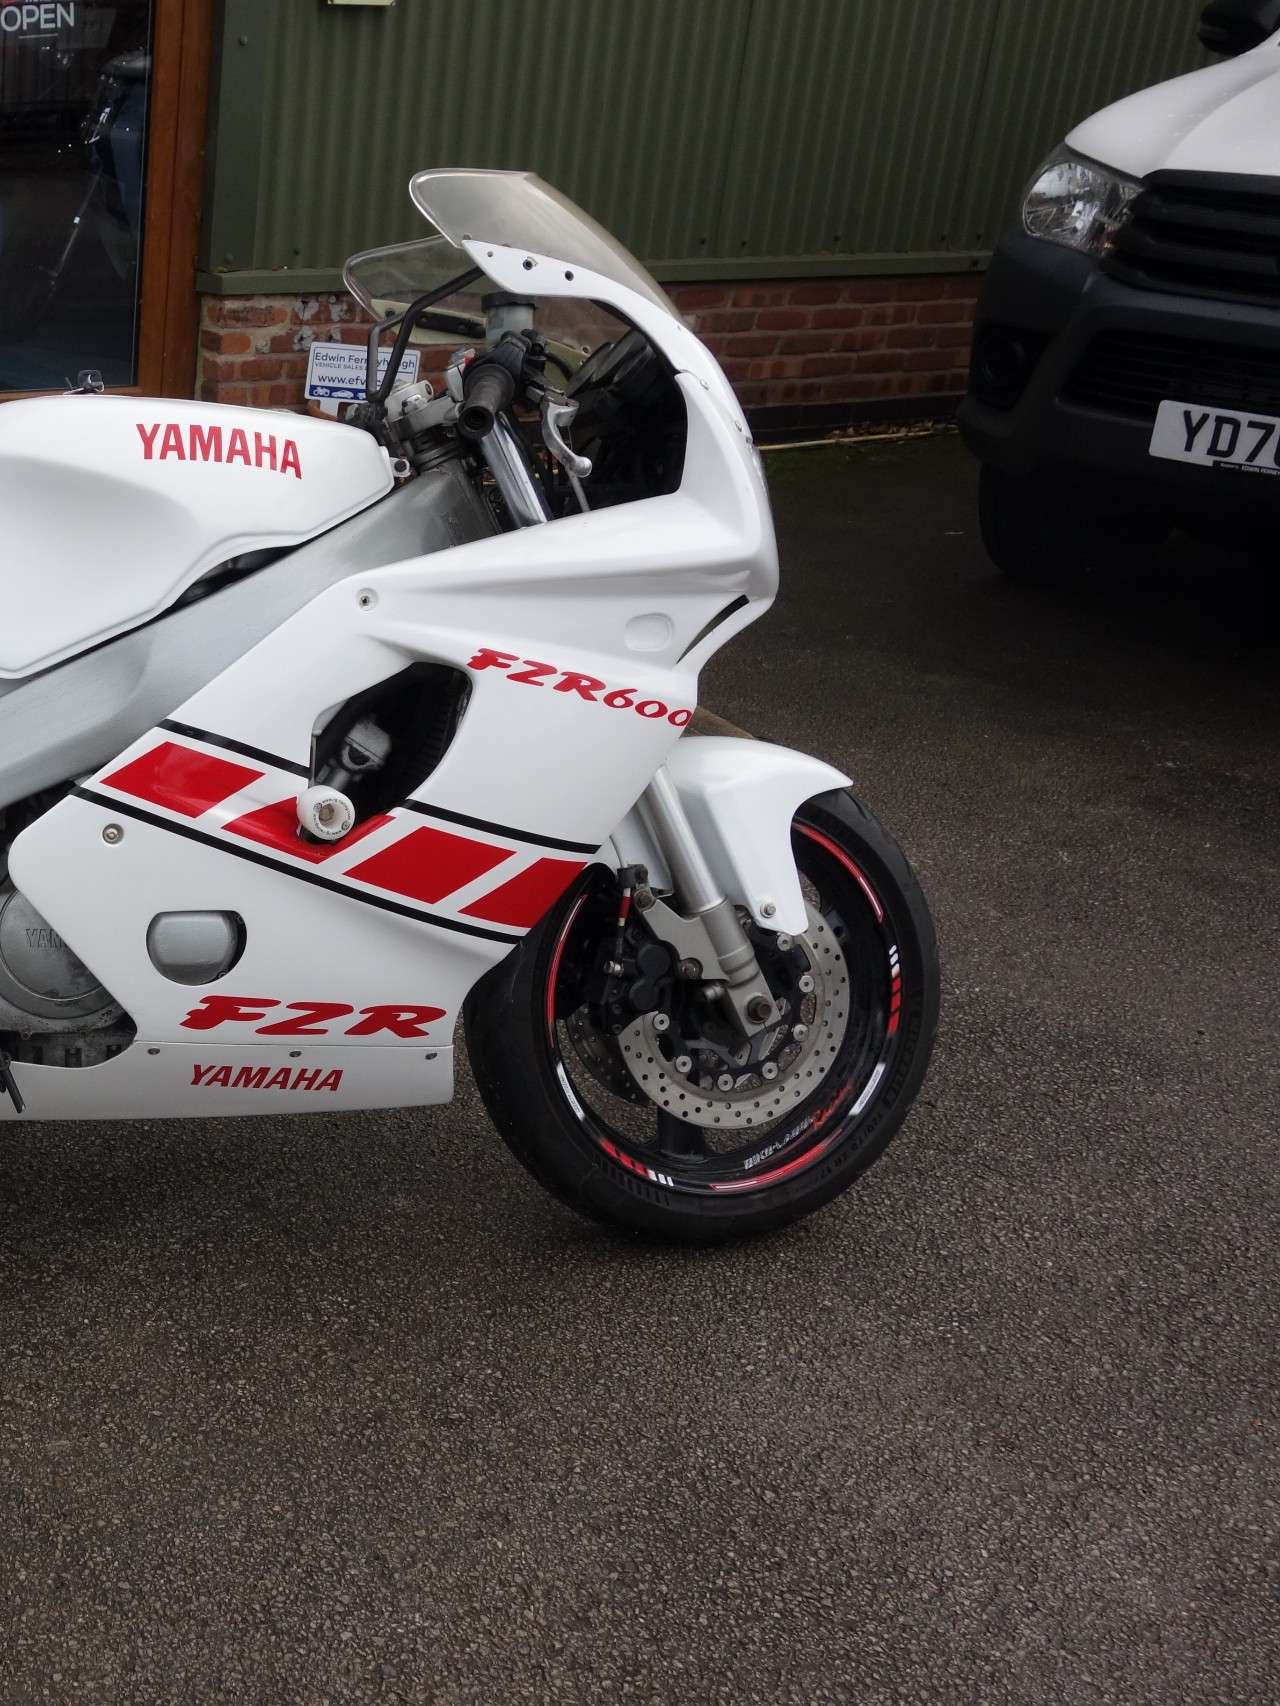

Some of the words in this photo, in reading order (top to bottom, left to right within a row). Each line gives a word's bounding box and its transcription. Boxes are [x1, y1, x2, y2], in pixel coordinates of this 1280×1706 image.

[0, 2, 75, 32] OPEN
[314, 351, 346, 364] Edwin
[135, 423, 303, 480] YAMAHA
[466, 647, 693, 727] FZR600
[179, 995, 447, 1039] FZR
[190, 1064, 344, 1092] YAMAHA
